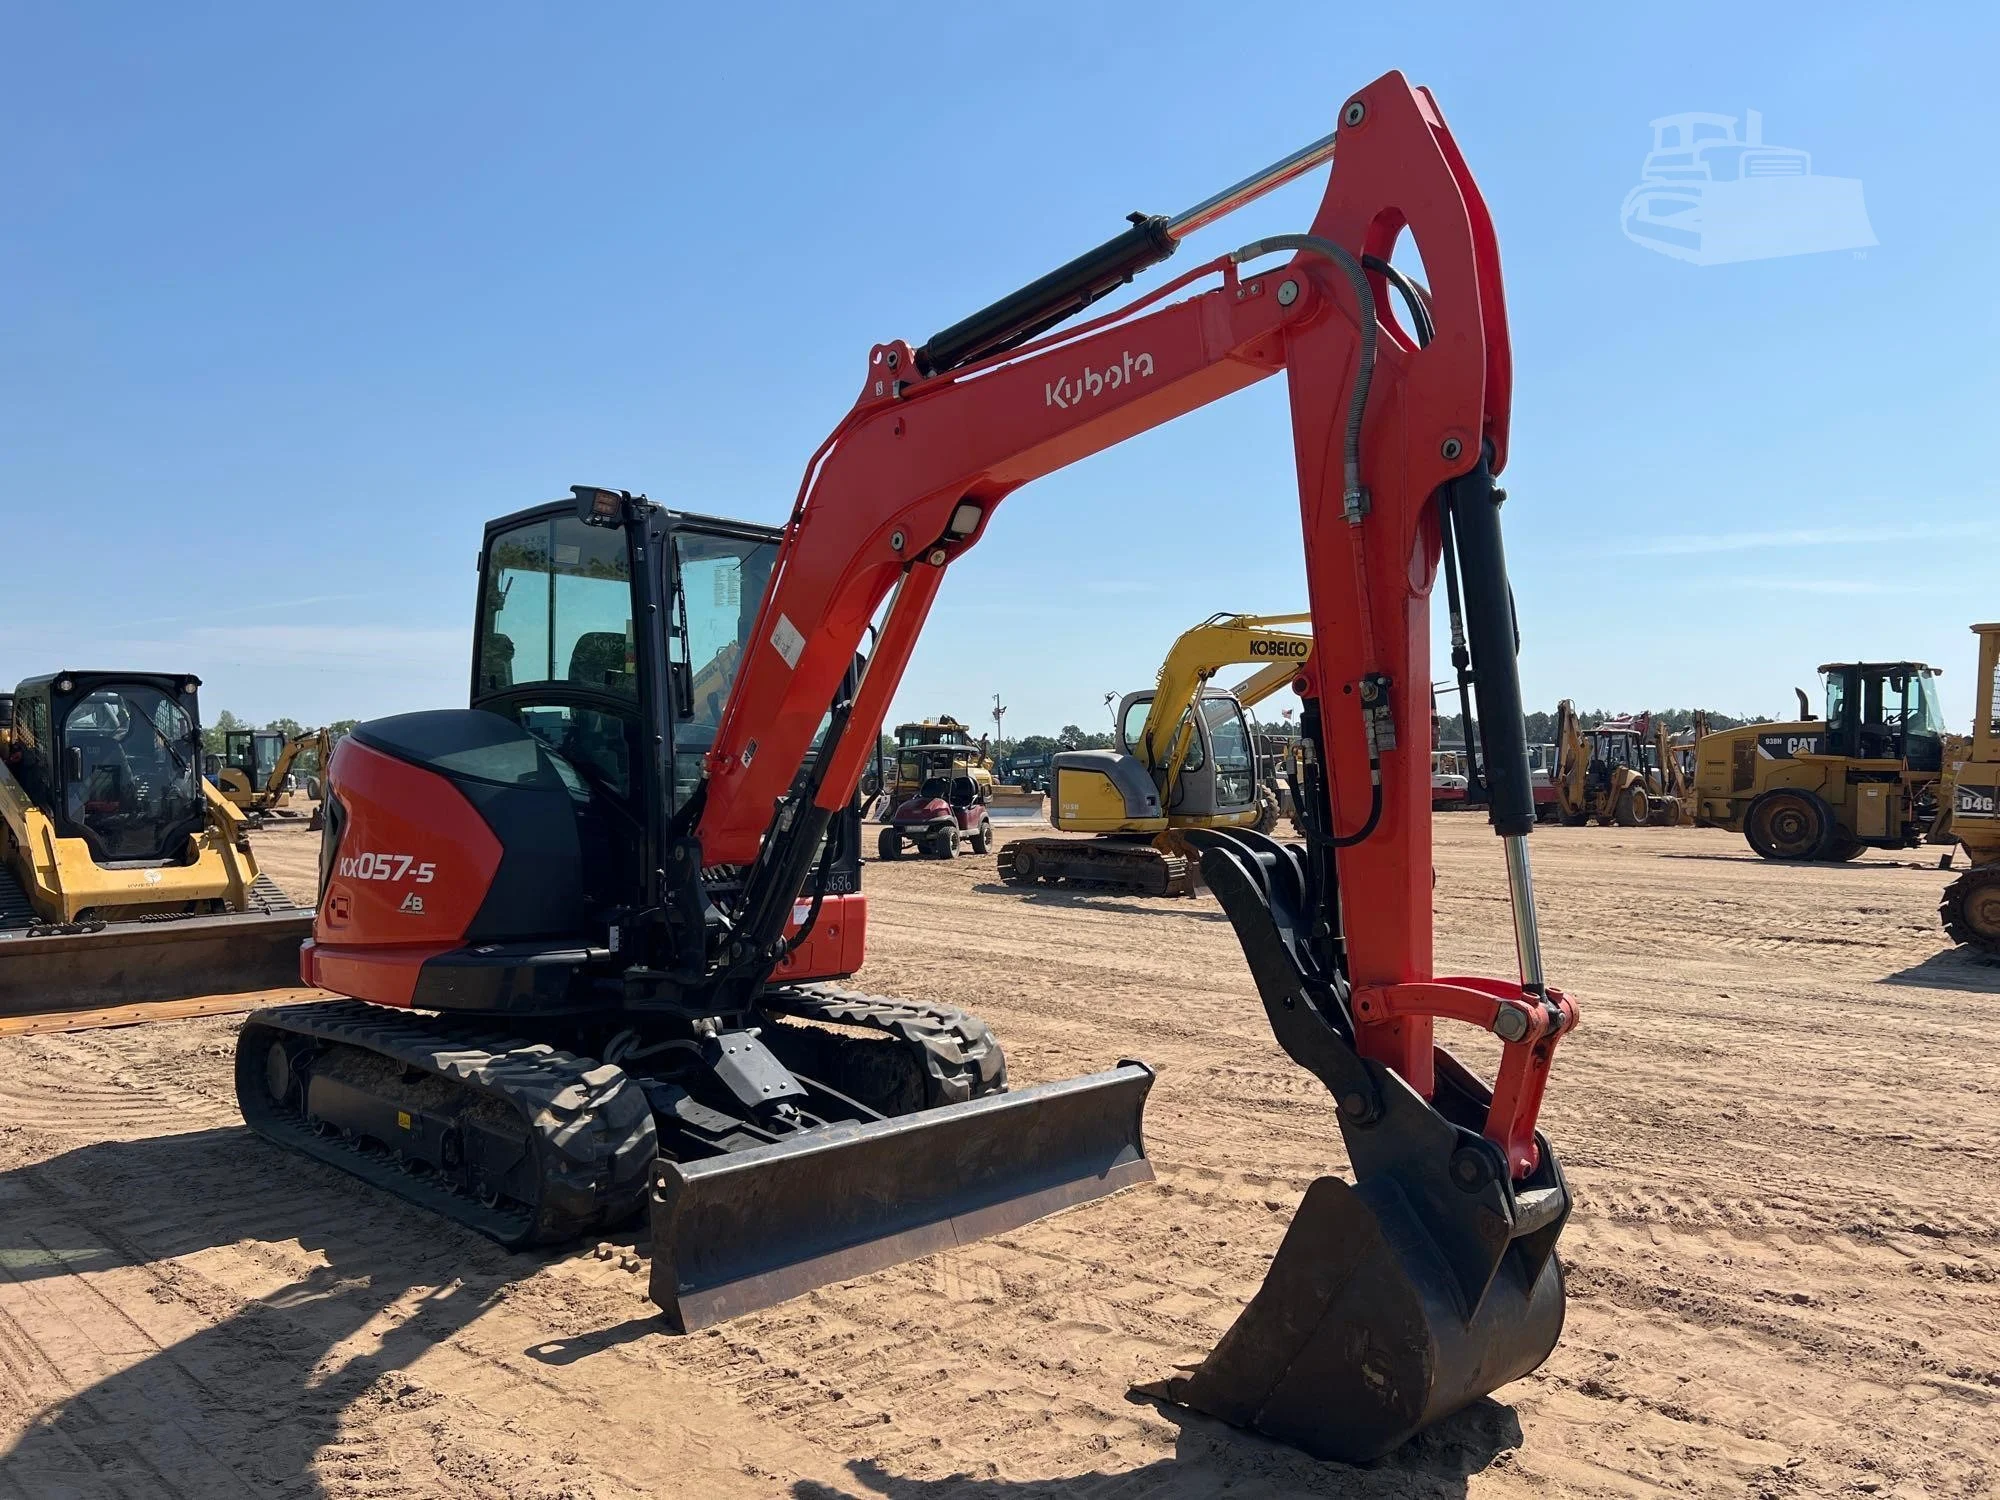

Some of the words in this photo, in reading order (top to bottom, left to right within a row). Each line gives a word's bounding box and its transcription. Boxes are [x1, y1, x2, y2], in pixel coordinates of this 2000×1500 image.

[1045, 350, 1154, 409] Kubota
[1249, 640, 1308, 657] KOBELCO
[1765, 737, 1783, 745] 938H
[1787, 737, 1818, 754] CAT
[1962, 797, 1994, 811] D4G
[339, 852, 437, 884] KX057-5
